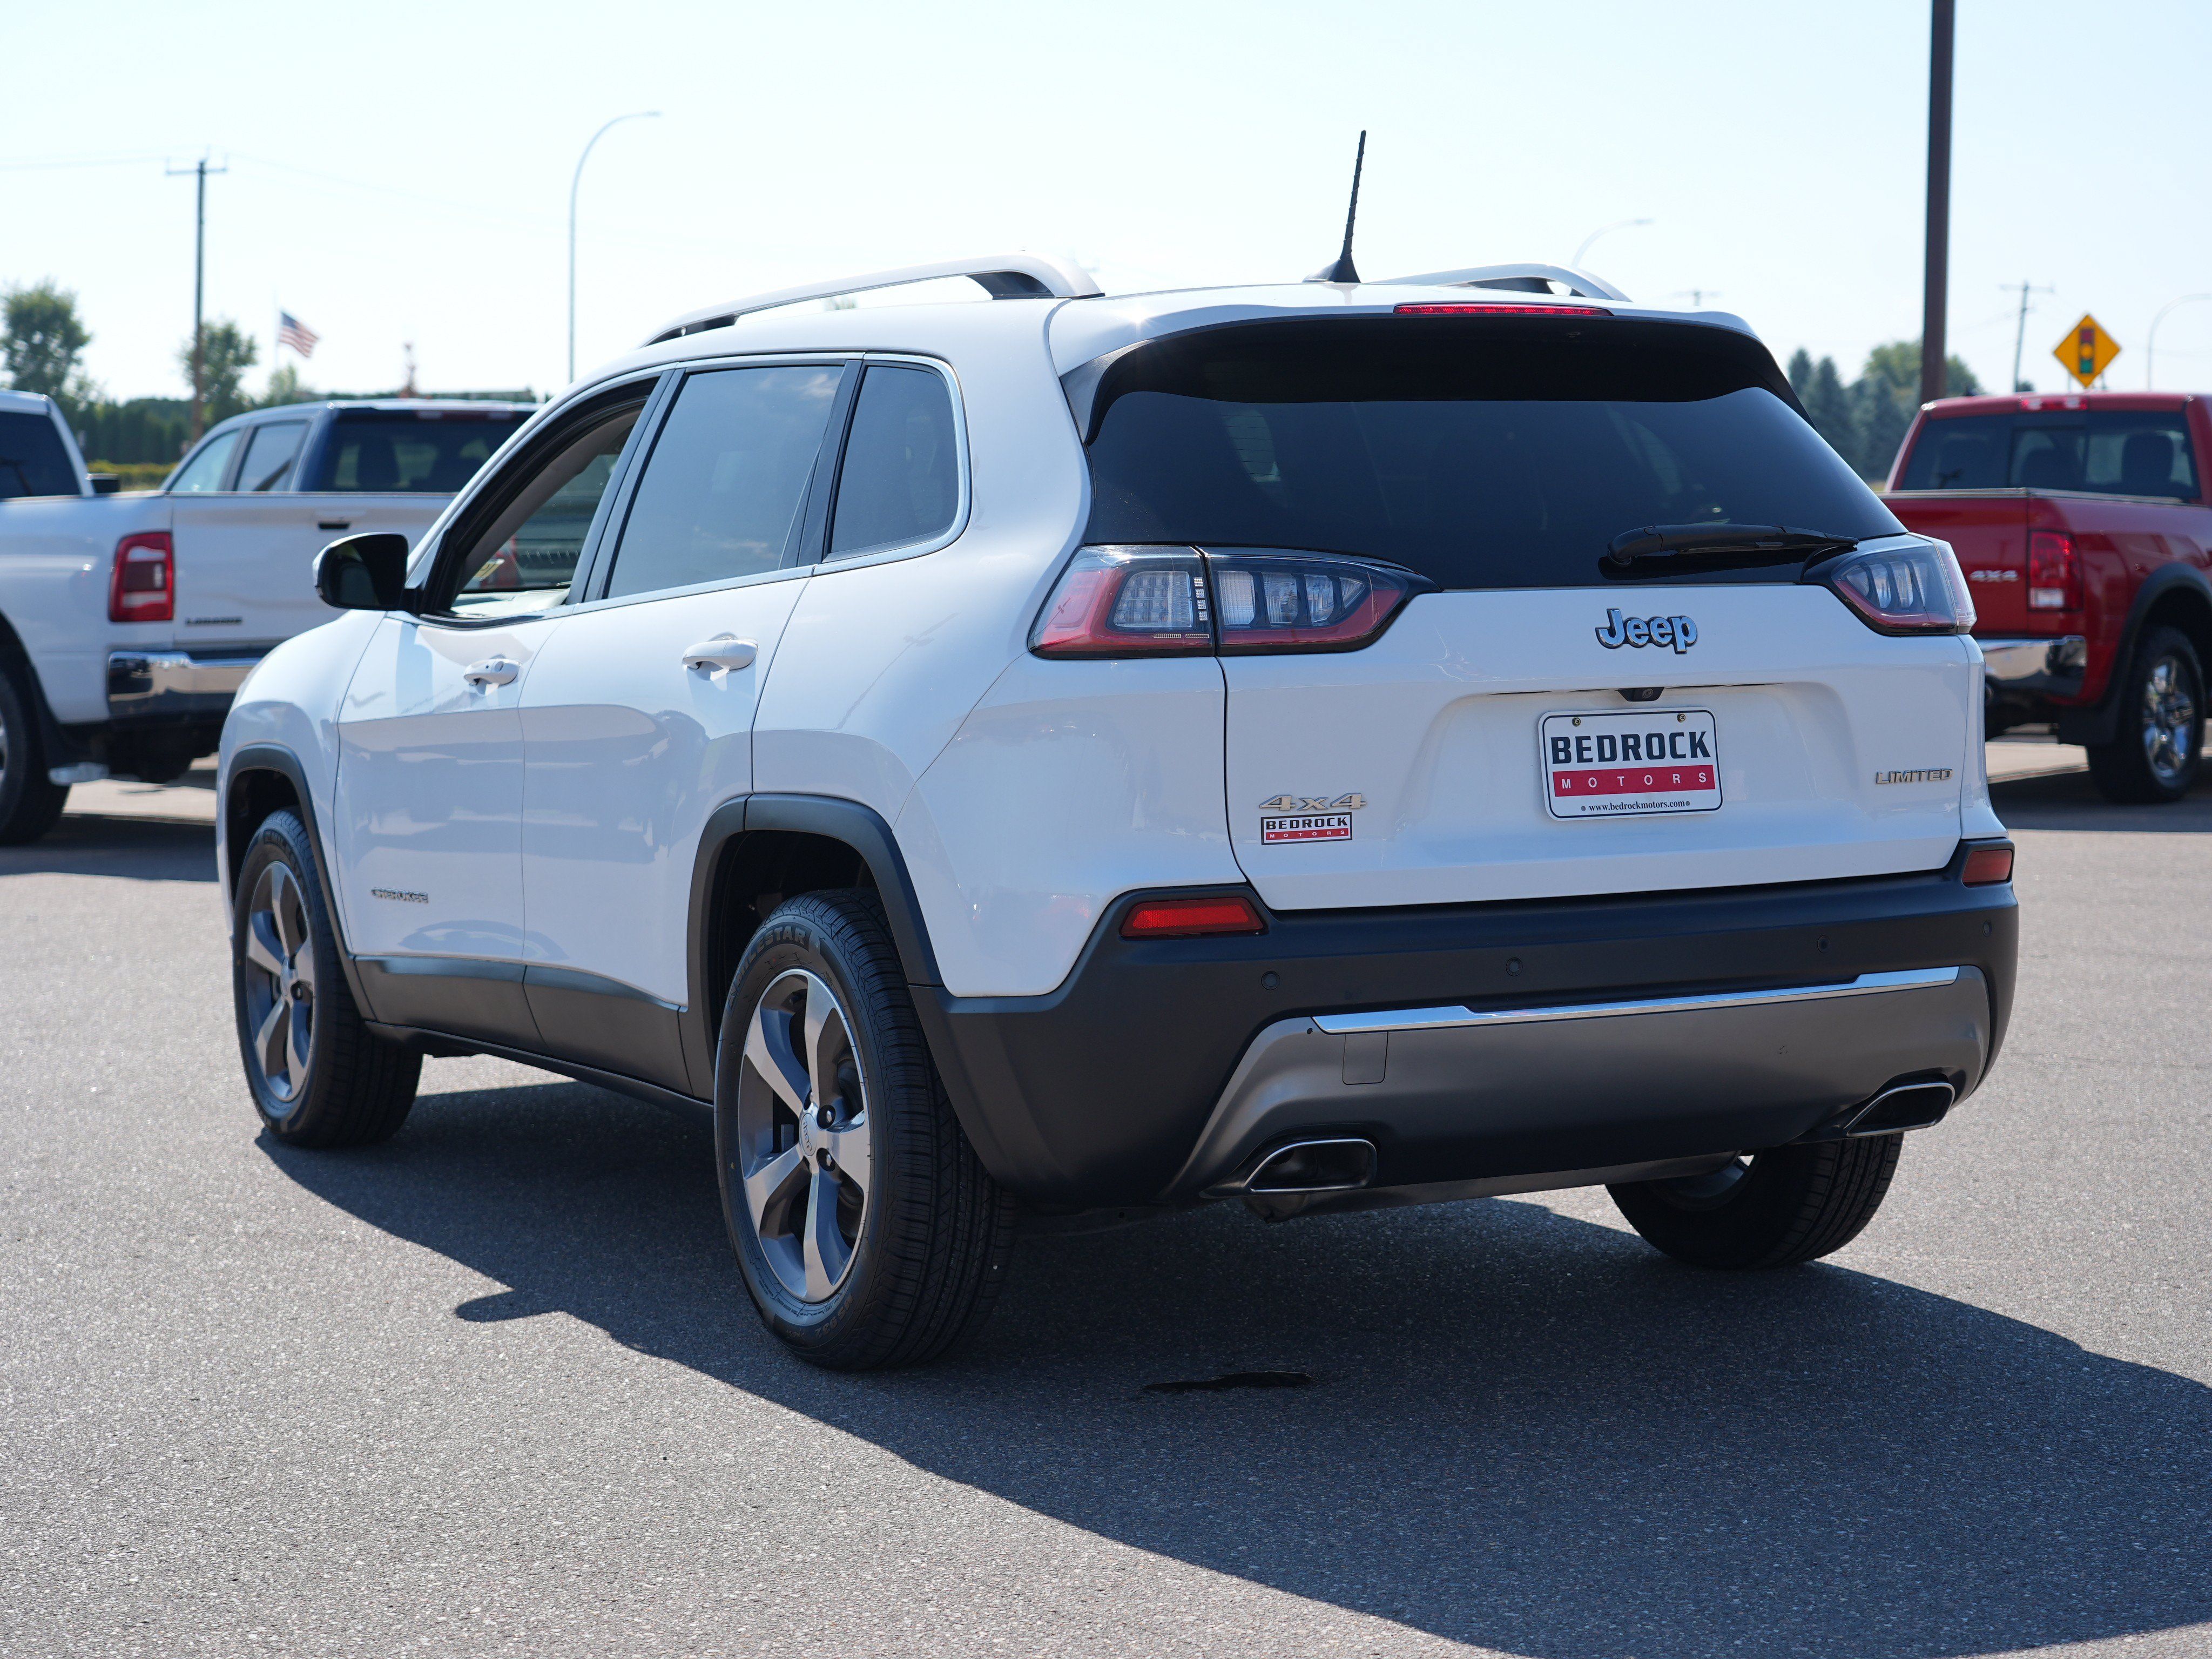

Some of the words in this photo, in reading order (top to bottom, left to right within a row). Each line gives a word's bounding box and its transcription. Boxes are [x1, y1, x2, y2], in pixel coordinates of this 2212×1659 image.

[1595, 608, 1697, 654] Jeep
[1550, 731, 1711, 764] BEDROCK
[1562, 772, 1707, 789] MOTORS
[1876, 768, 1953, 784] LIMITED
[1589, 800, 1685, 812] www.bedrockmotors.com
[1266, 817, 1348, 830] BEDROCK
[1270, 830, 1345, 838] MOTORS
[371, 887, 429, 903] CHEROKEE
